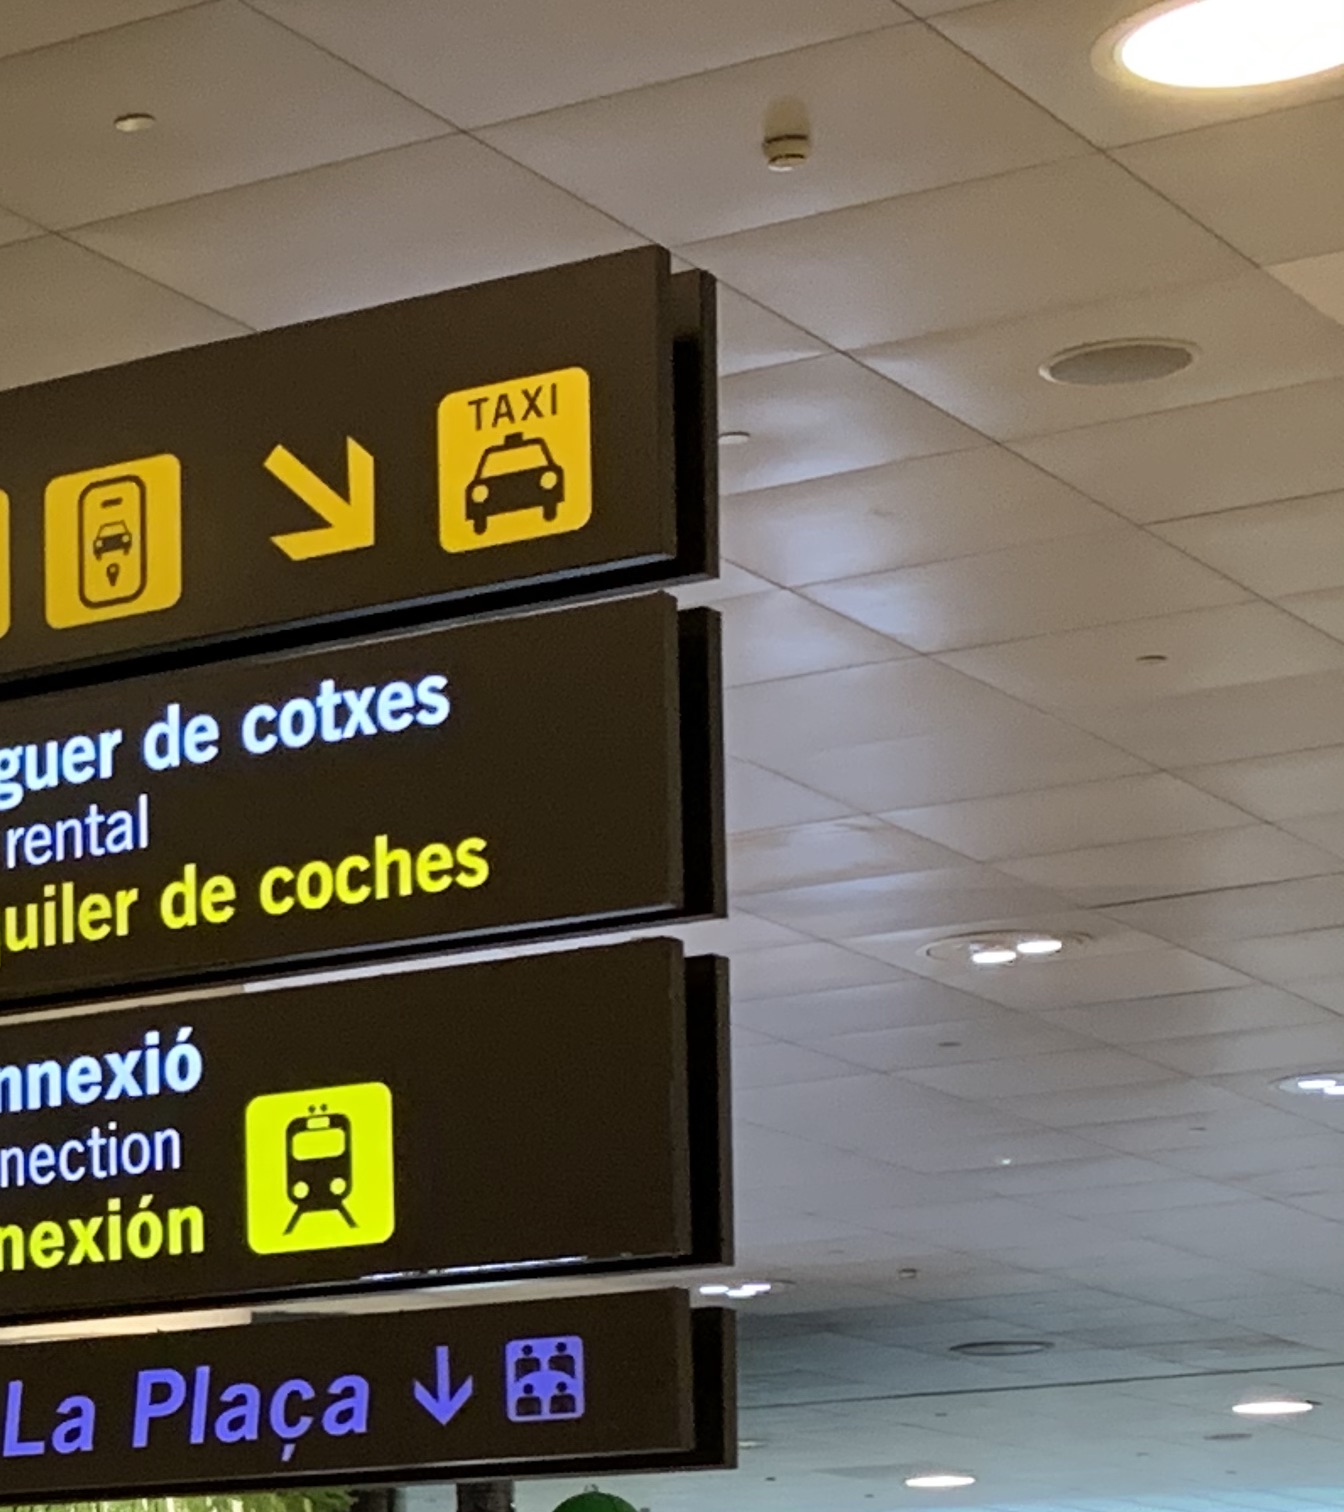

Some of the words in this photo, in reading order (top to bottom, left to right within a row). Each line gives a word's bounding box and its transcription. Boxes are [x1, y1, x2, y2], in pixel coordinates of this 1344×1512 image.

[468, 383, 558, 432] TAXI
[142, 703, 220, 771] de
[241, 674, 451, 754] cotxes
[4, 796, 148, 868] rental
[160, 863, 236, 930] de
[259, 834, 489, 915] coches
[2, 1380, 96, 1457] La
[132, 1365, 369, 1461] Plaça
